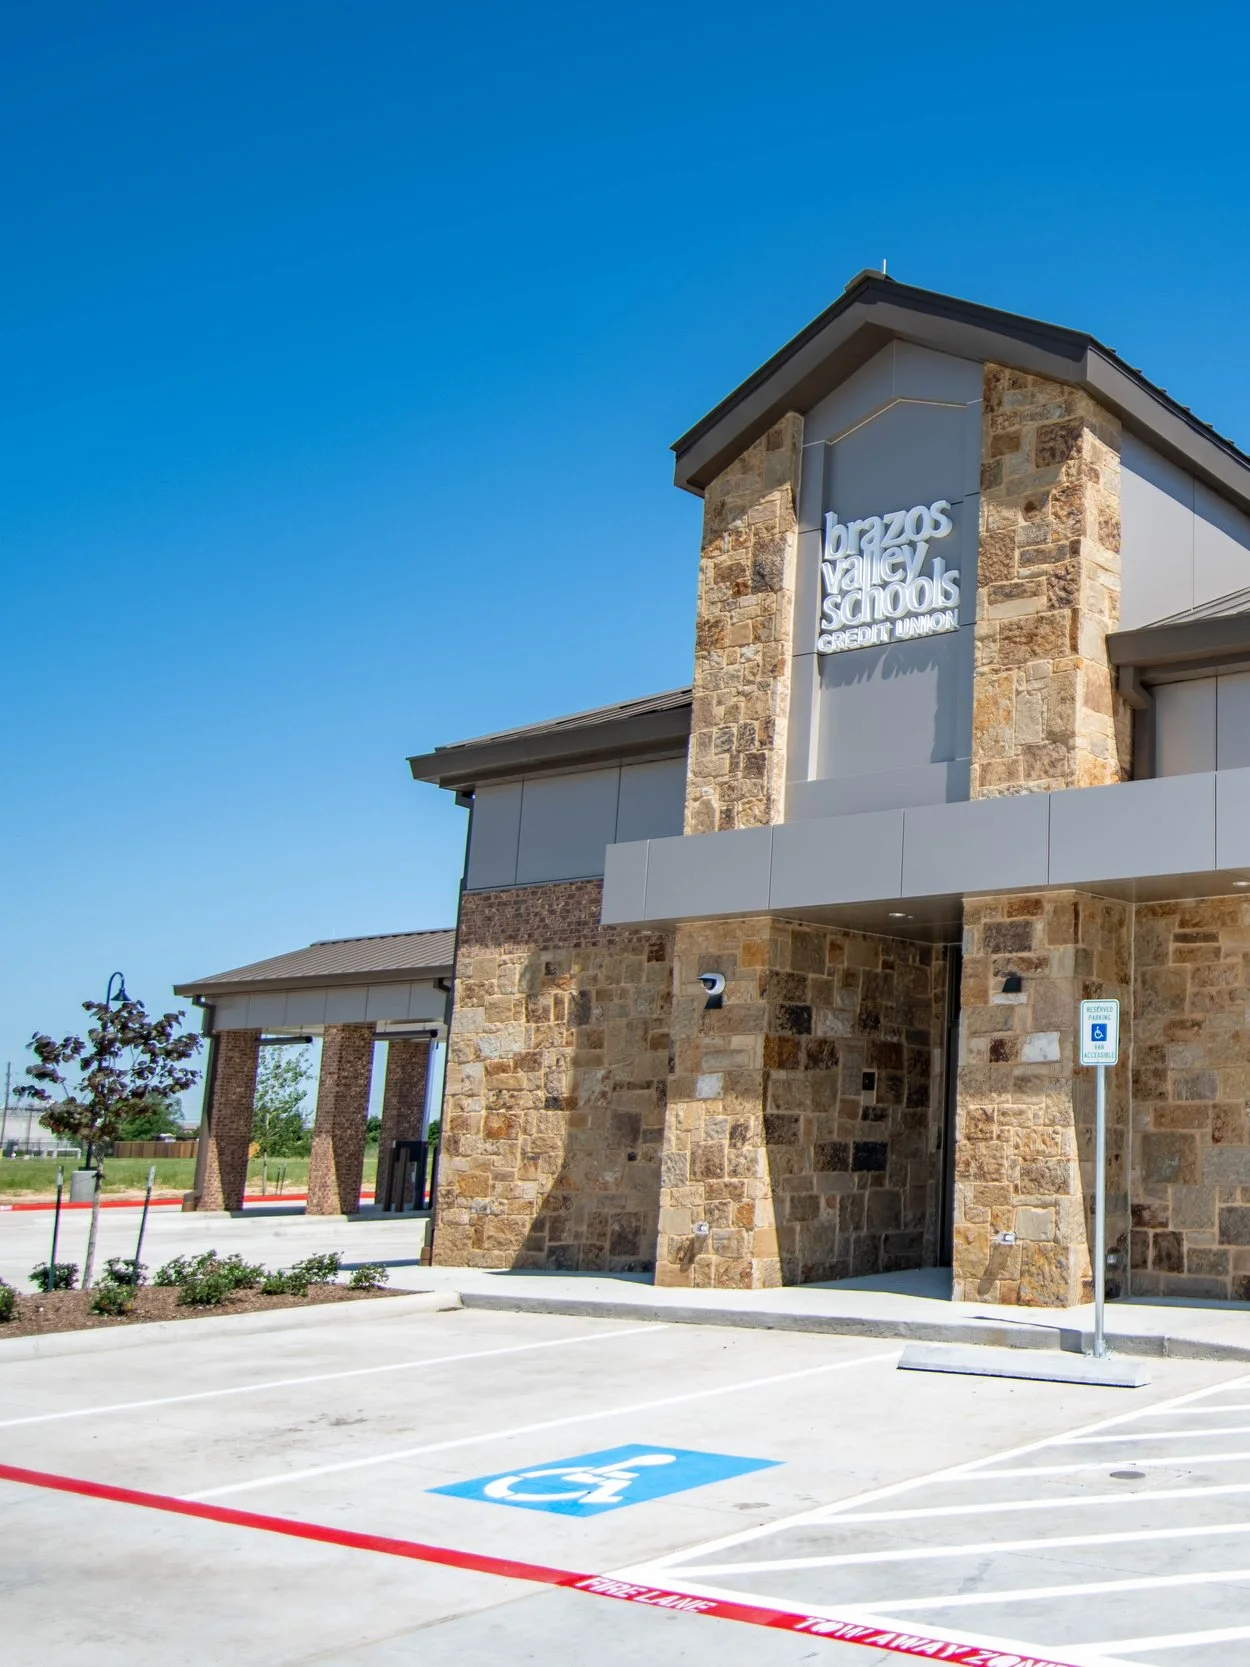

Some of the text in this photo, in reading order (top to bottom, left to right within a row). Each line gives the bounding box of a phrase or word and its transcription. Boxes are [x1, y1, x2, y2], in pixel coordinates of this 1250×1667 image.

[824, 500, 953, 559] brazos
[821, 542, 929, 595] valley
[822, 557, 960, 630] schools
[818, 609, 960, 653] CREDIT UNION
[575, 1576, 717, 1612] FIRE LANE
[793, 1616, 875, 1639] TOW
[864, 1632, 972, 1658] AWAY
